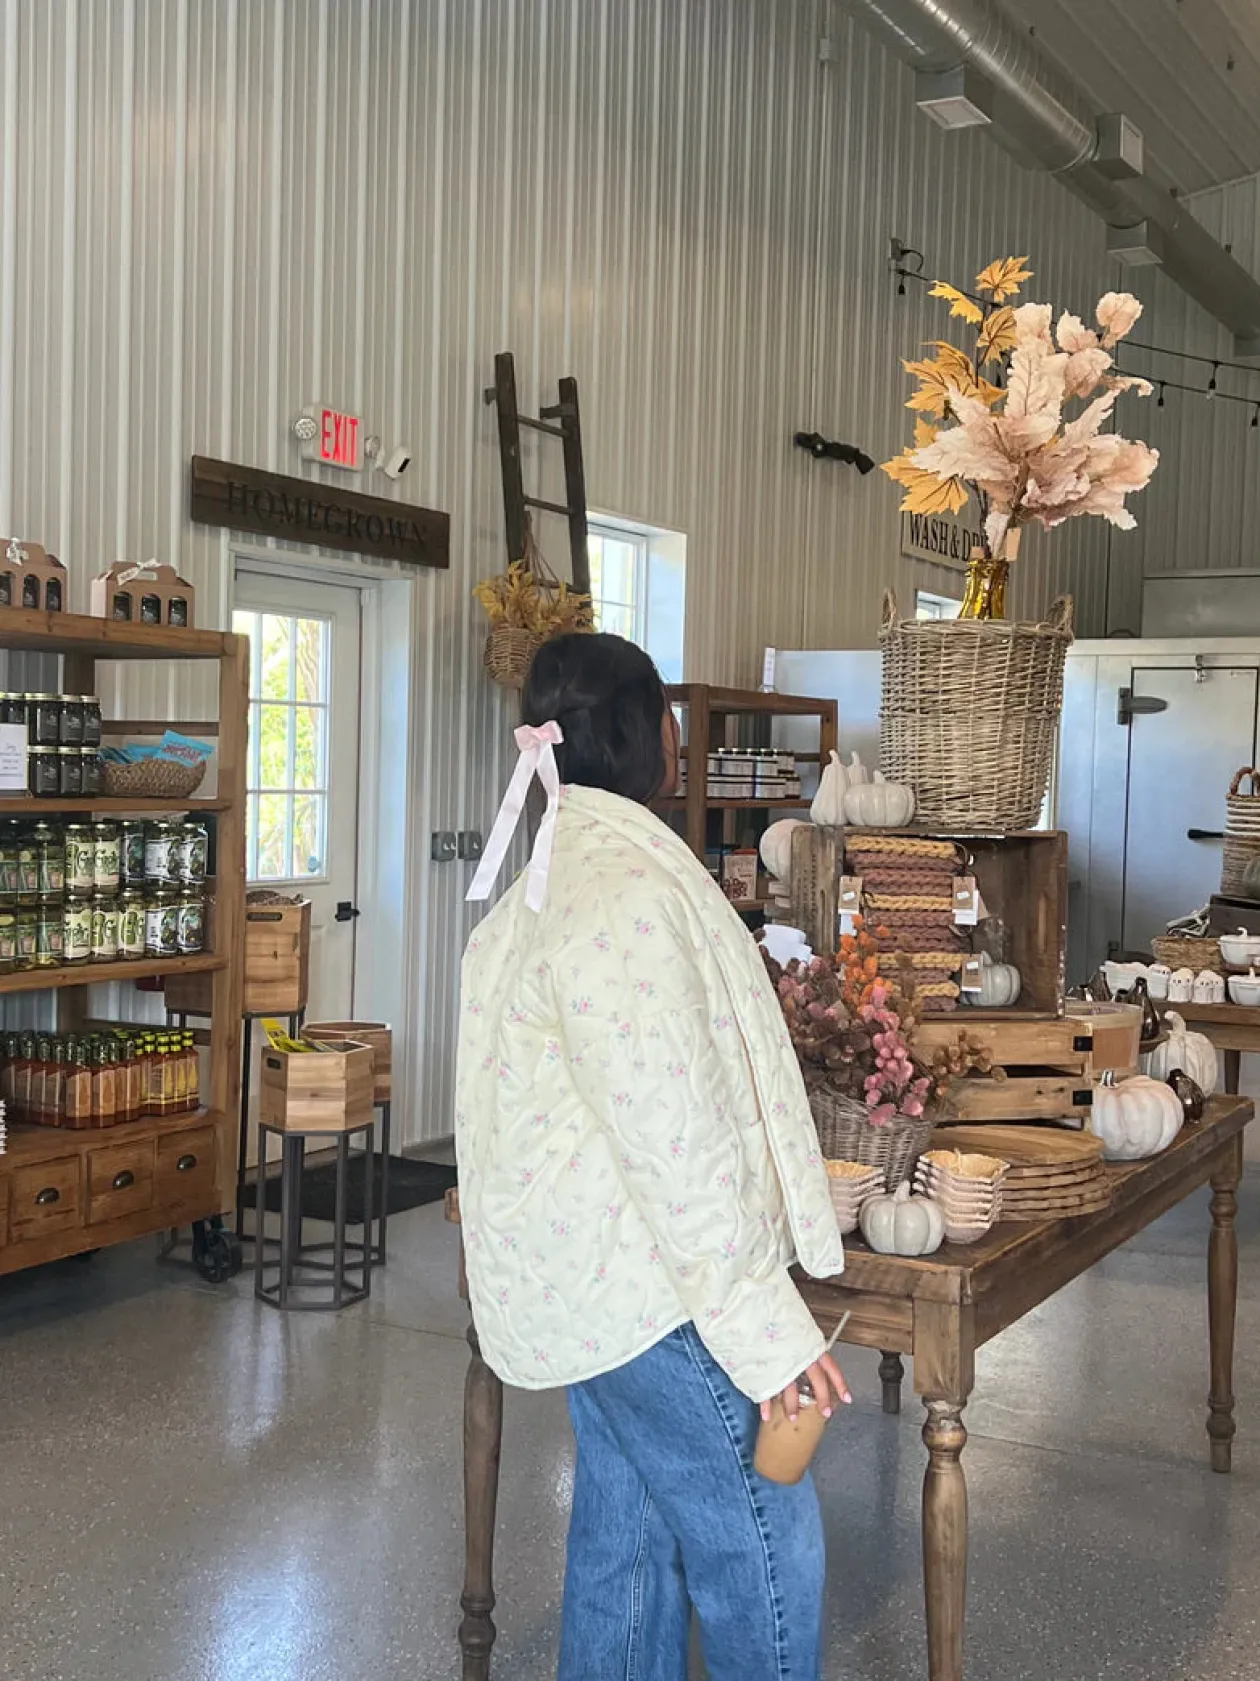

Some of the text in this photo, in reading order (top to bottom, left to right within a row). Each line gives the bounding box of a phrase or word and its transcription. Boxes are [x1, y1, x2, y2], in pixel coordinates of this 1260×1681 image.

[321, 410, 358, 466] EXIT
[228, 483, 427, 549] HOMEGROWN
[910, 511, 949, 555] WASH
